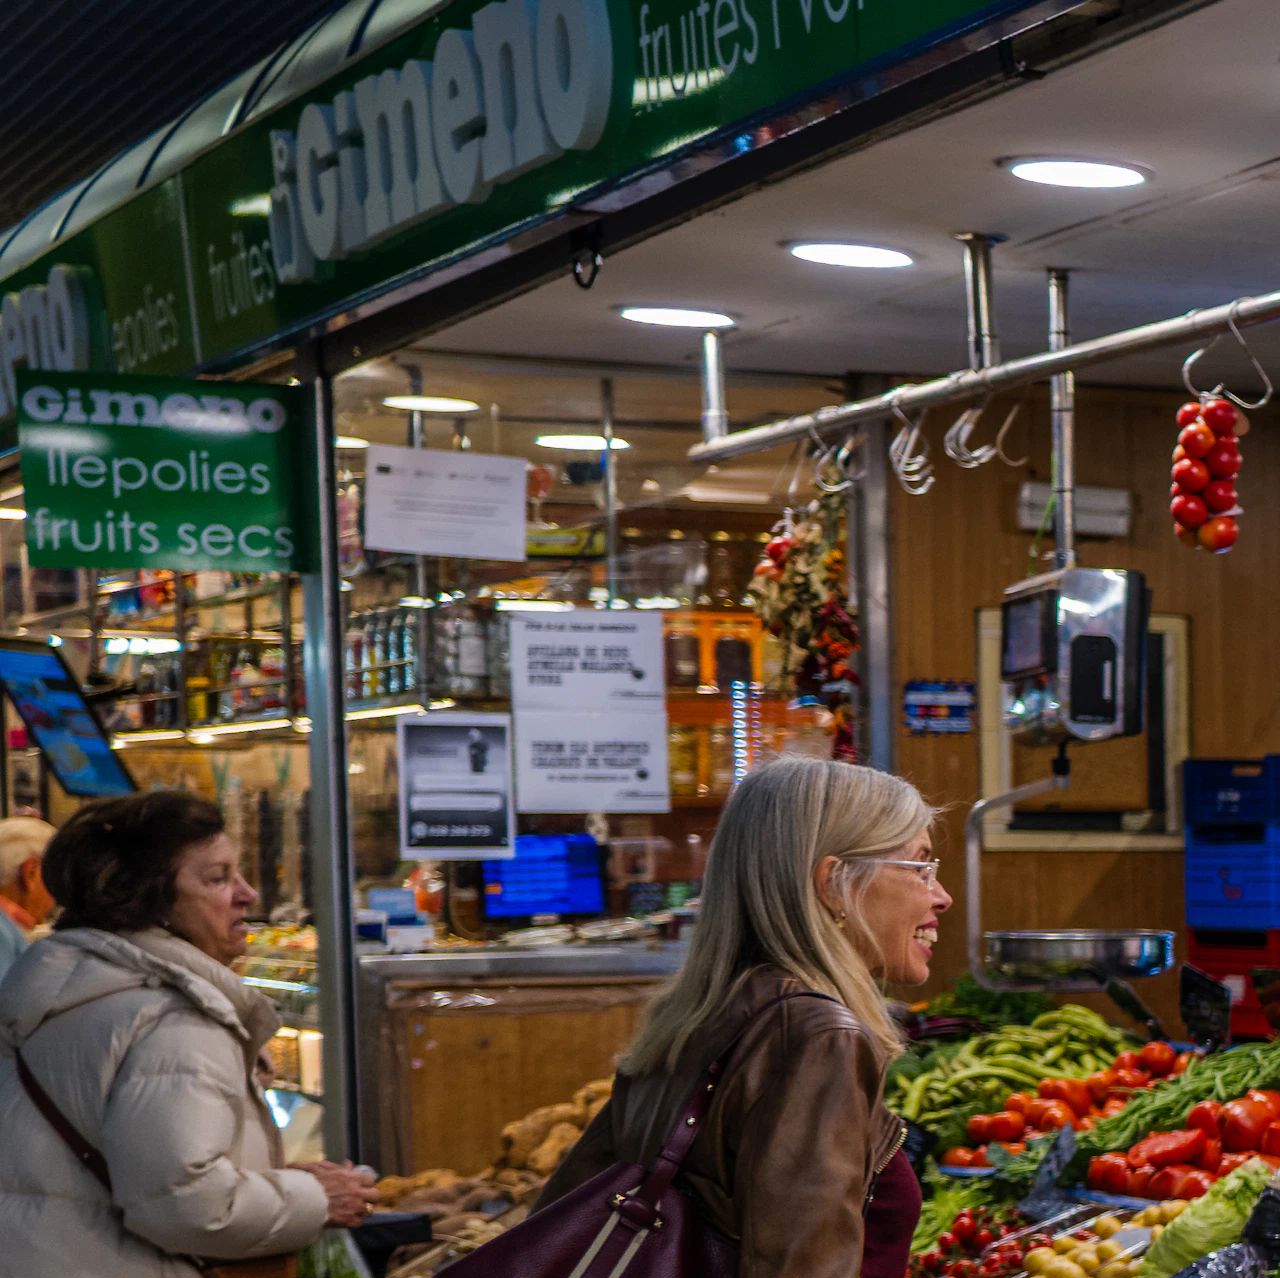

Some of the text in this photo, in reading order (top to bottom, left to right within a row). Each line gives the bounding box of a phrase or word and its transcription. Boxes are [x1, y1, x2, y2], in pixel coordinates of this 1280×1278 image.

[22, 385, 287, 433] Gimeno
[48, 450, 271, 498] llepolies
[32, 507, 294, 558] fruits secs
